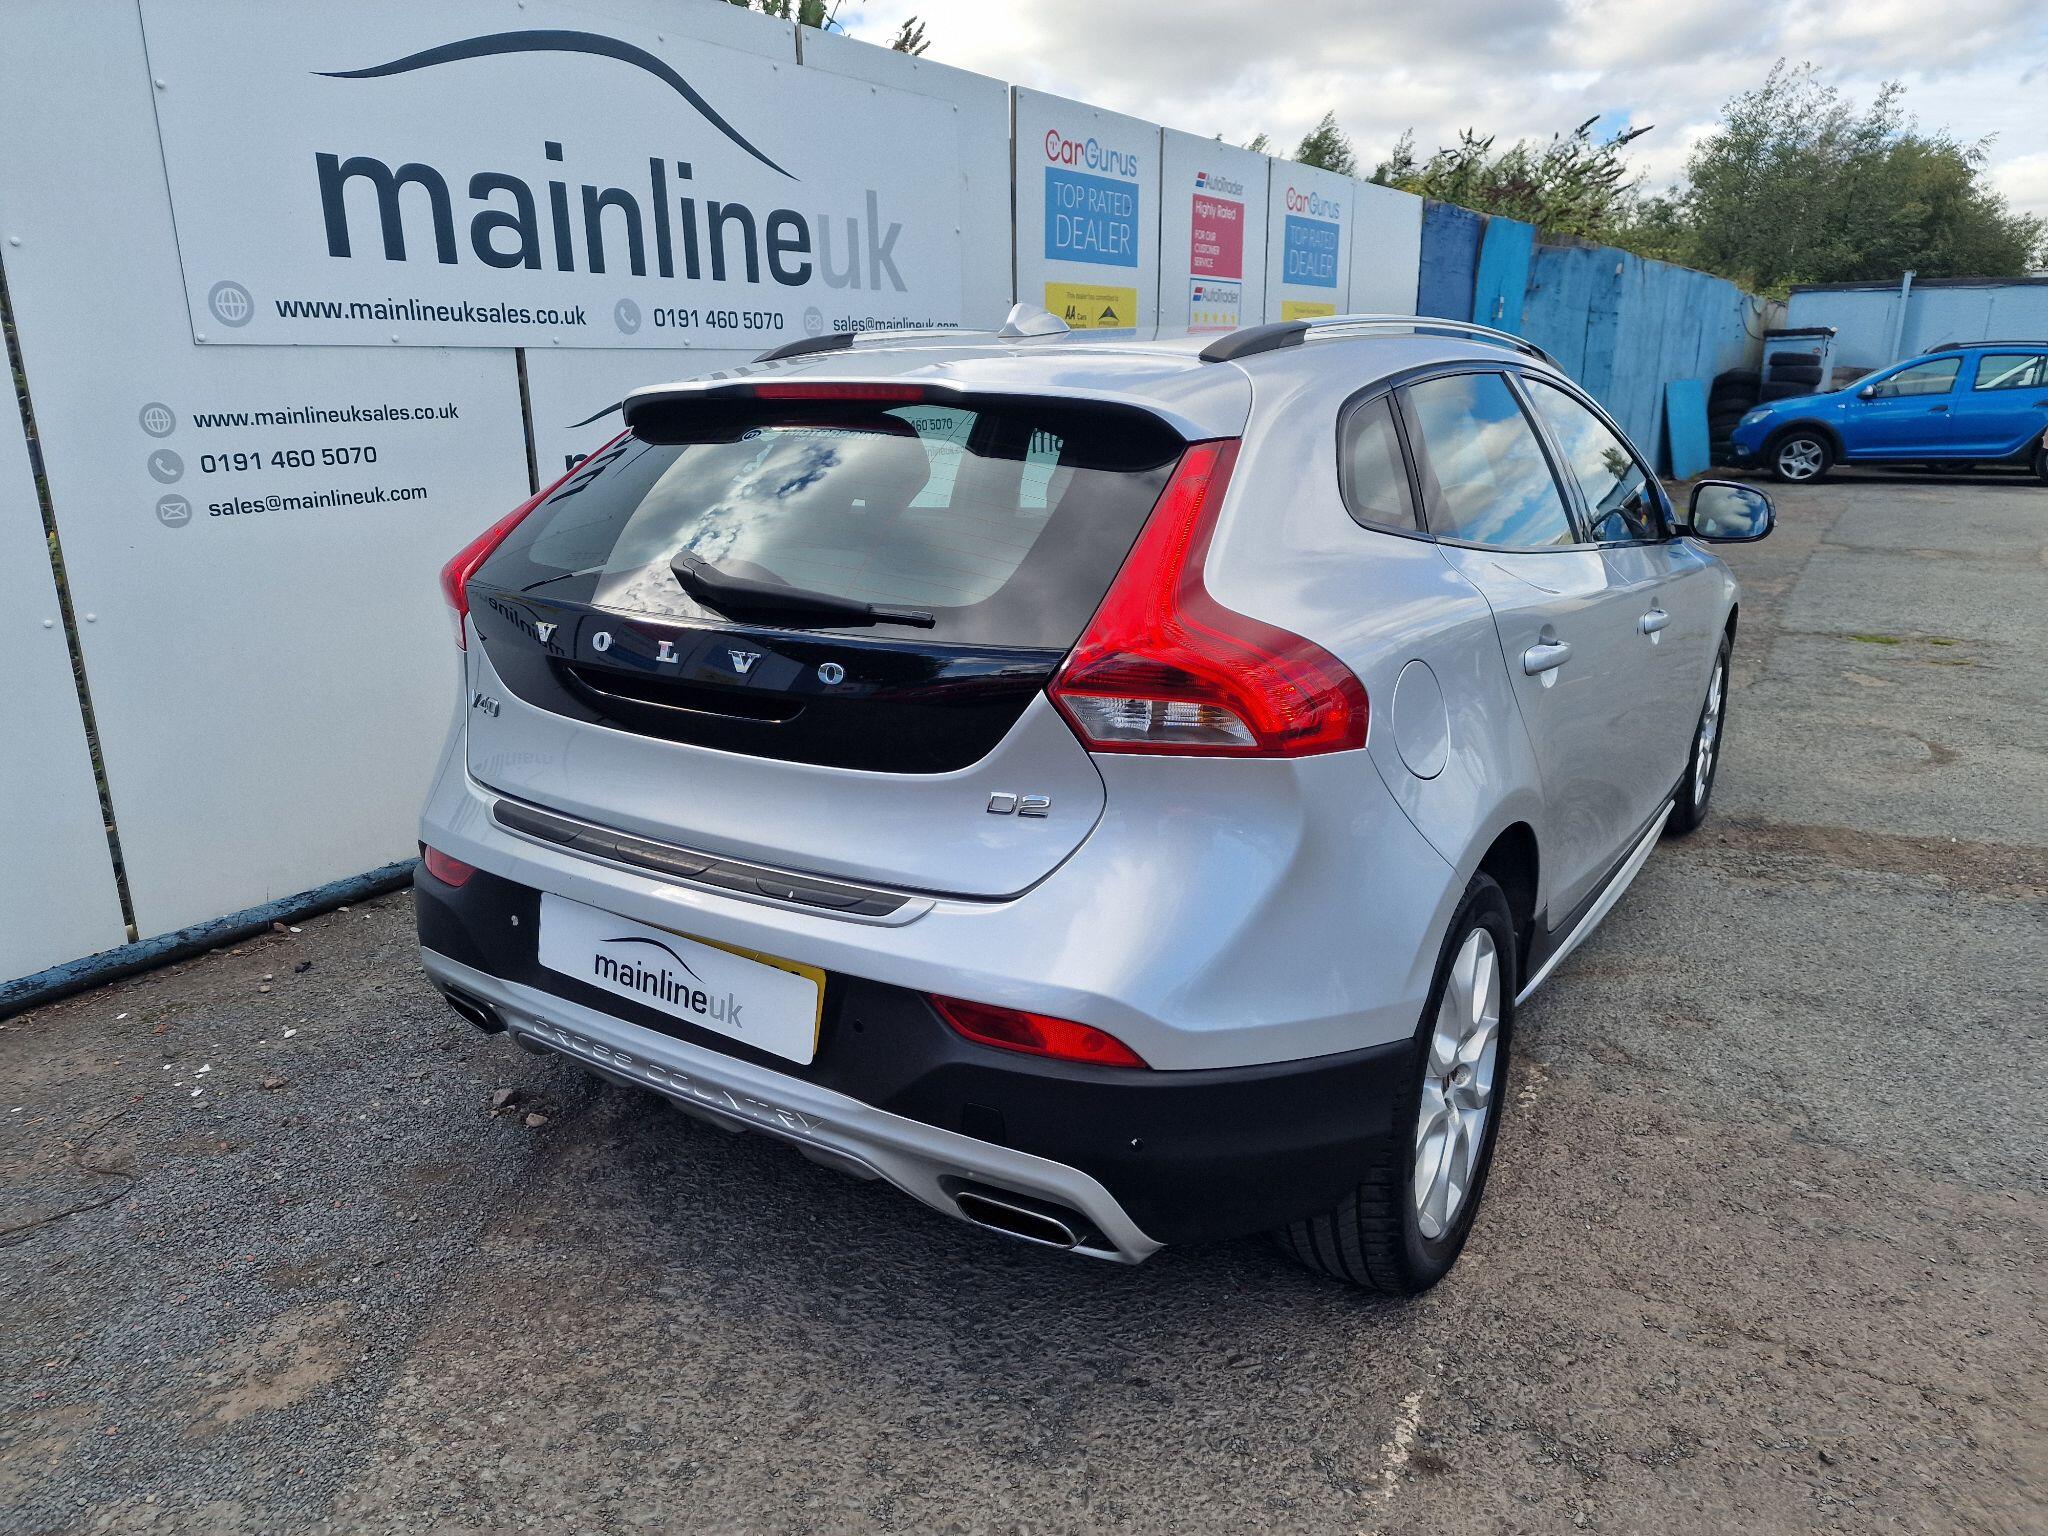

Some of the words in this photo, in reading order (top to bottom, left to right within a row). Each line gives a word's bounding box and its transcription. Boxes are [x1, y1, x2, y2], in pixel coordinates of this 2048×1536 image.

[1045, 129, 1138, 178] CarGurus
[1053, 181, 1085, 209] TOP
[1088, 187, 1133, 217] RATED
[1195, 200, 1217, 220] Highly
[1217, 204, 1237, 221] Rated
[1286, 186, 1341, 219] CarGurus
[315, 140, 908, 293] mainlineuk
[1056, 214, 1132, 255] DEALER
[1194, 229, 1206, 240] FOR
[1206, 231, 1217, 242] OUR
[1290, 225, 1308, 245] TOP
[1309, 229, 1336, 250] RATED
[1289, 250, 1333, 278] DEALER
[275, 298, 587, 327] www.mainlineuksales.co.uk
[653, 308, 700, 328] 0191
[706, 310, 739, 330] 460
[743, 311, 784, 331] 5070
[193, 402, 460, 428] www.mainlineuksales.co.uk
[931, 417, 953, 430] 5070
[200, 451, 263, 474] 0191
[270, 448, 316, 469] 460
[321, 446, 378, 467] 5070
[208, 486, 428, 517] sales@mainlineuk.com
[535, 621, 845, 685] VOLVO
[471, 688, 500, 718] V40
[987, 791, 1052, 818] D2
[594, 953, 744, 1029] mainlineuk
